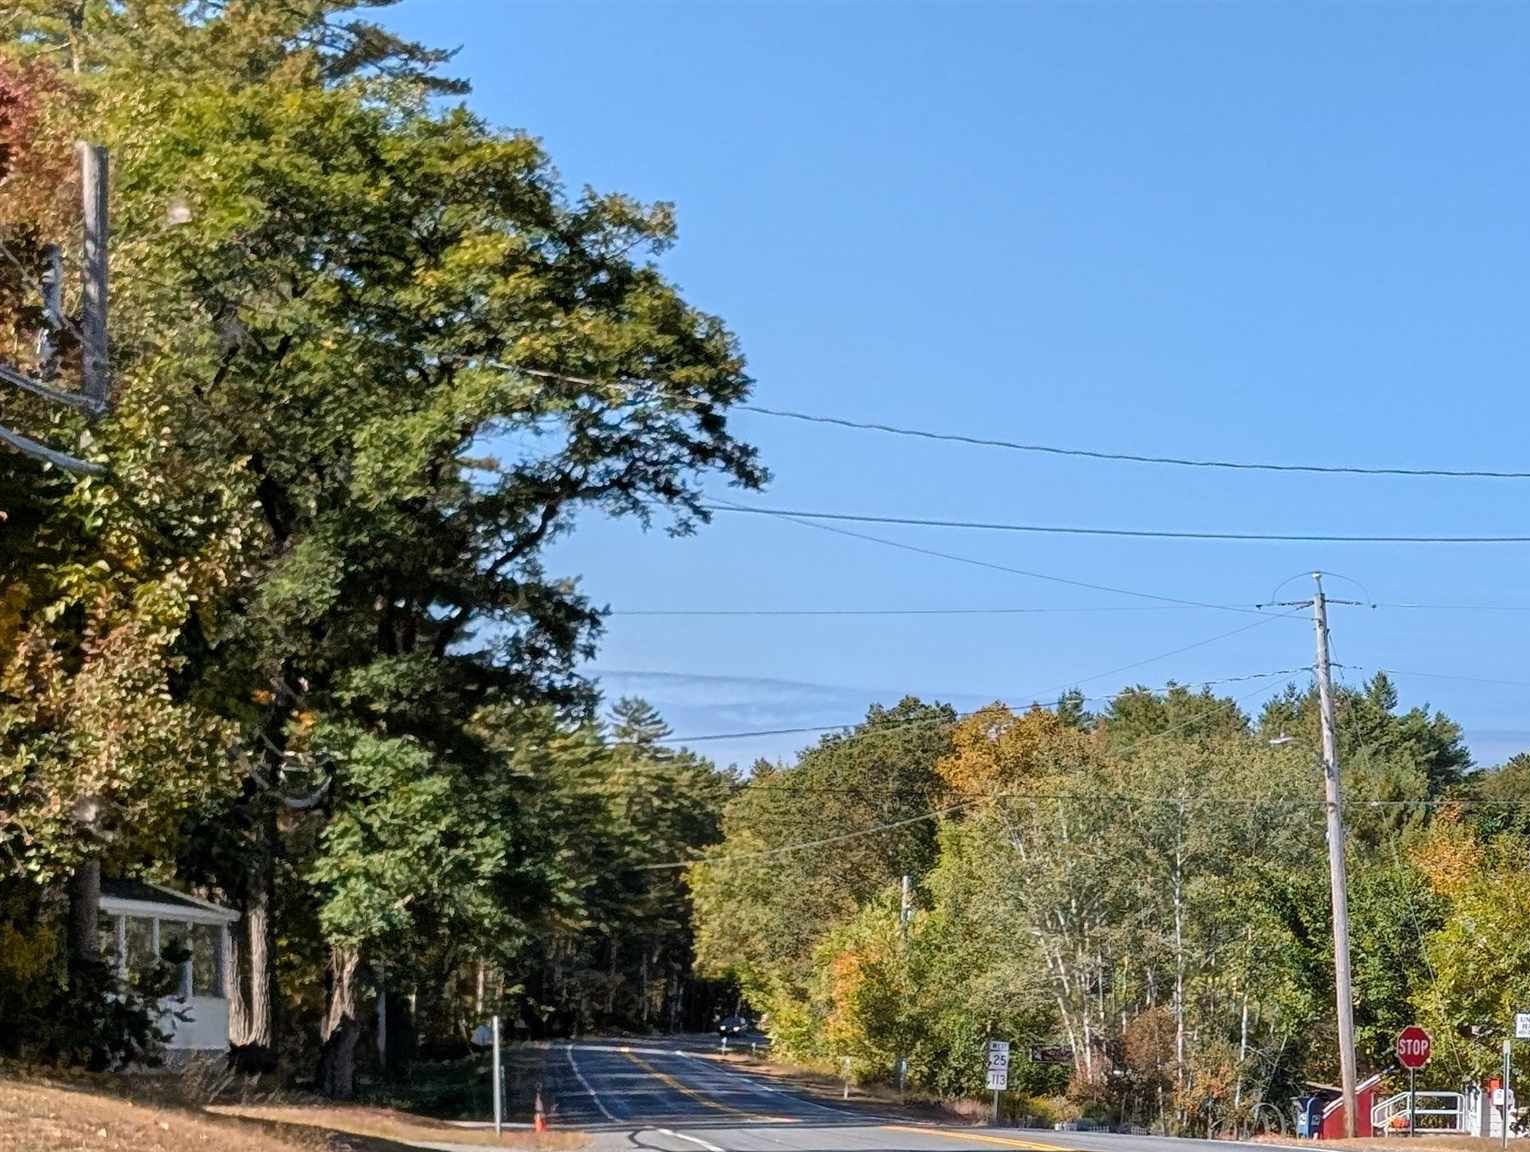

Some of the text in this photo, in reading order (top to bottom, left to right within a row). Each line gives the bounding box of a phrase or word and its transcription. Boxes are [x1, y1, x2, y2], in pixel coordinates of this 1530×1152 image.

[1399, 1038, 1429, 1056] STOP
[993, 1054, 1007, 1066] 25
[992, 1074, 1006, 1086] 113
